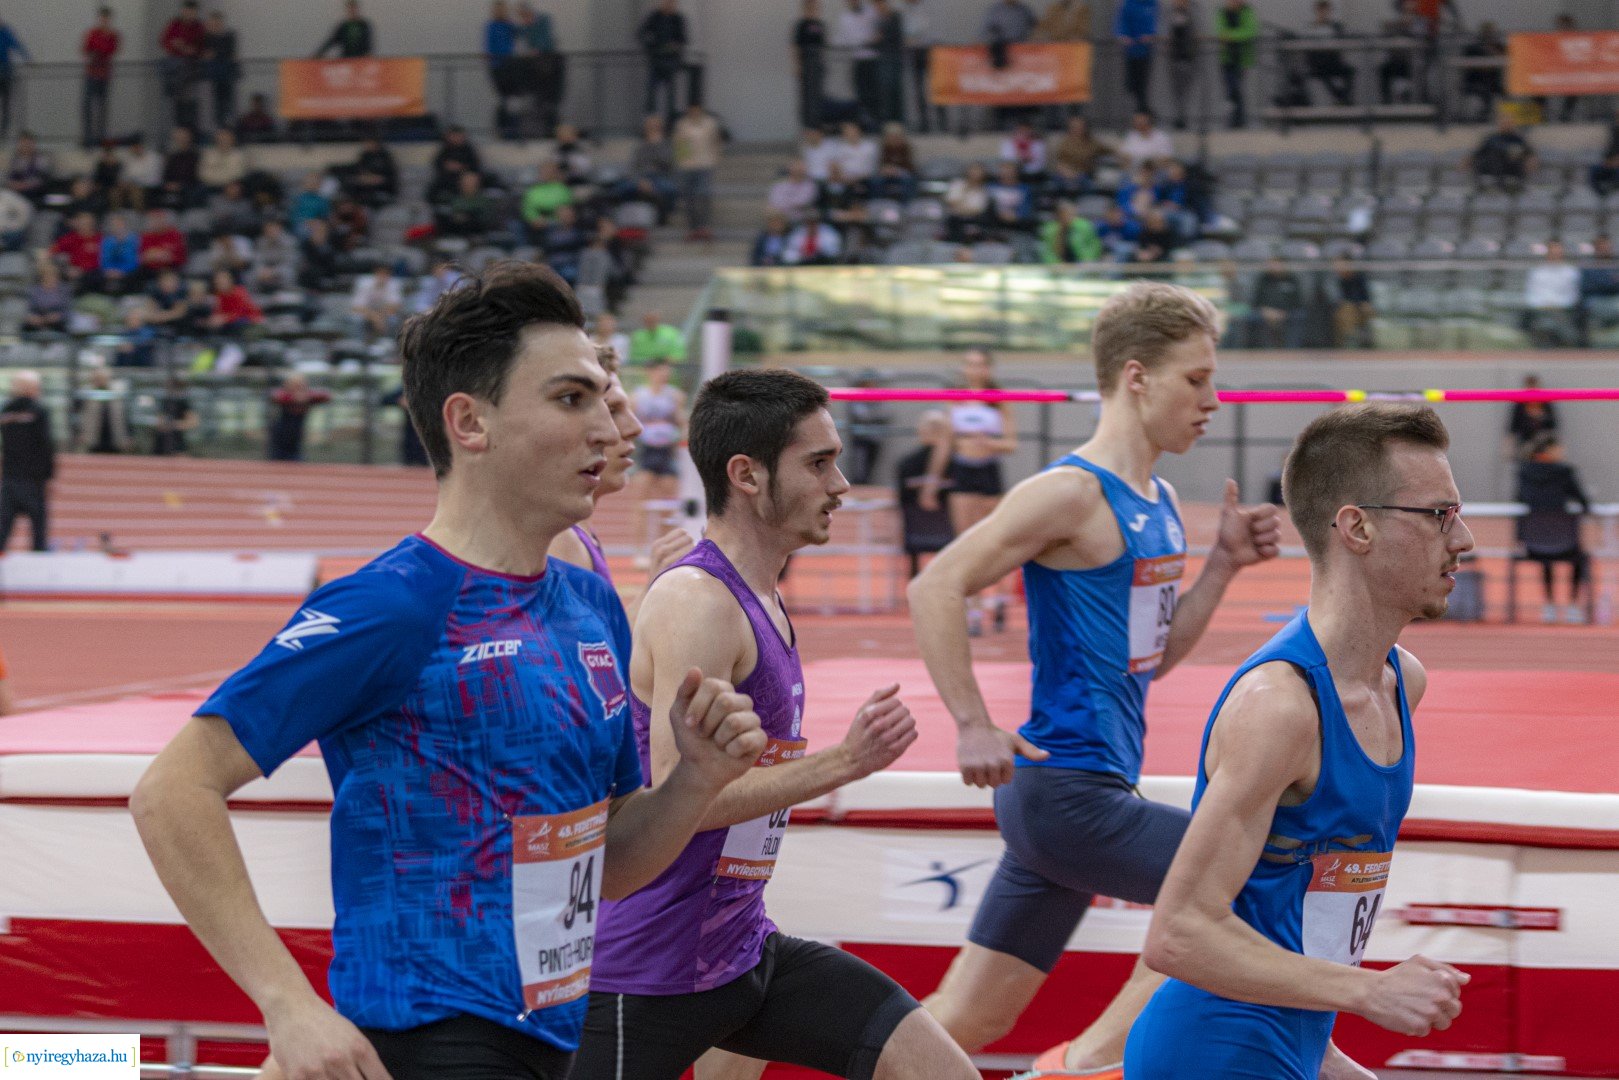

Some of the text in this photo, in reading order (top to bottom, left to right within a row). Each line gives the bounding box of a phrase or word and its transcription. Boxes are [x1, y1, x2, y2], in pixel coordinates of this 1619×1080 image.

[564, 856, 594, 930] 94
[1344, 863, 1361, 874] 49.
[1350, 894, 1381, 956] 64
